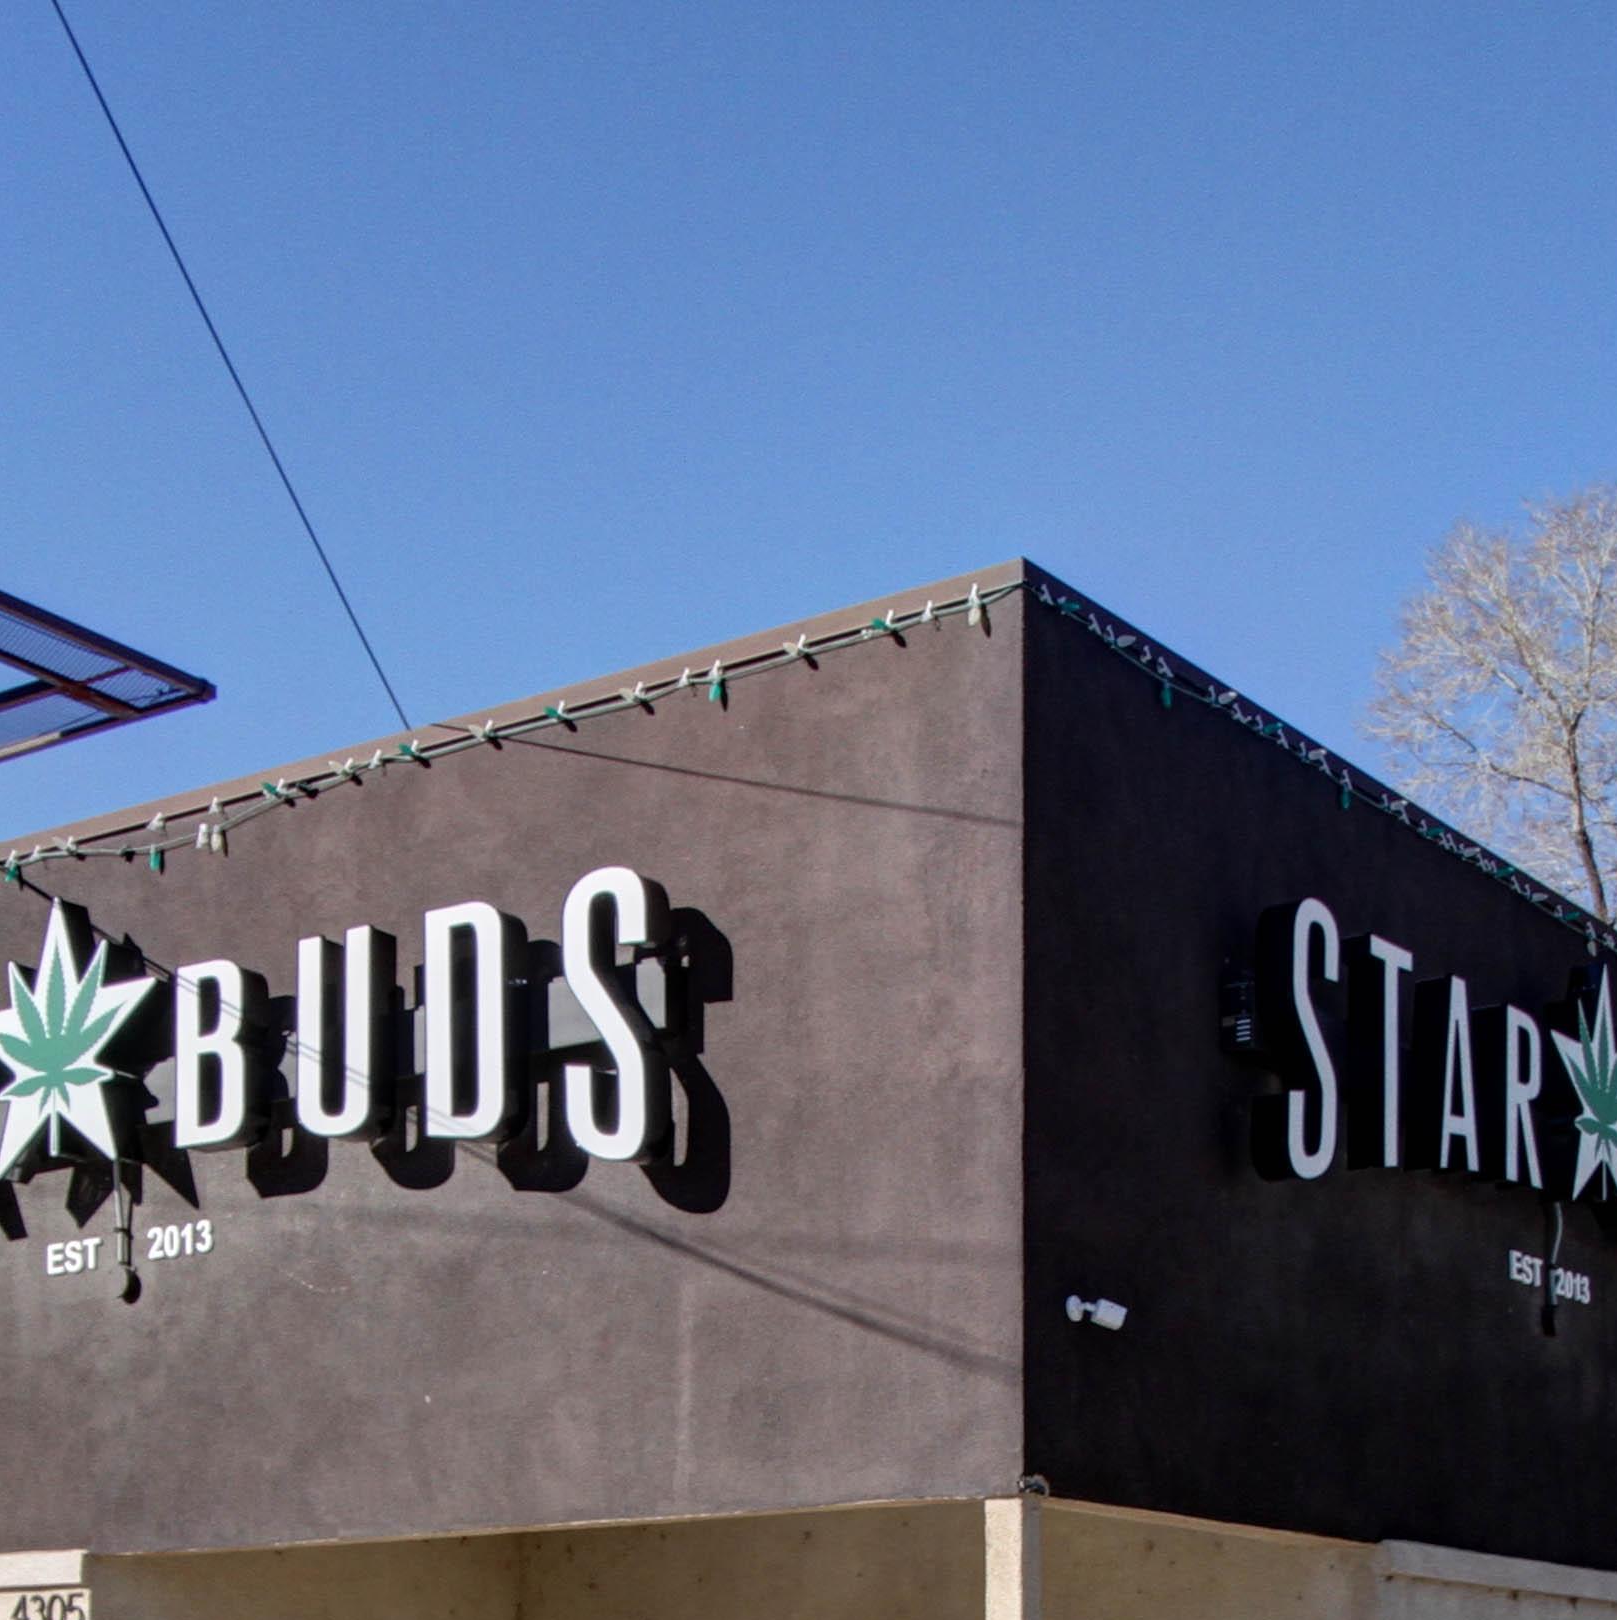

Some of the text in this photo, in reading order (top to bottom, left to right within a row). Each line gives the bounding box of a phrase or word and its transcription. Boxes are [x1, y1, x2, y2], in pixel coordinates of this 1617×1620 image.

[176, 866, 651, 1161] BUDS
[1288, 897, 1543, 1190] STAR
[46, 1220, 214, 1276] EST 2013
[1508, 1249, 1591, 1305] EST 2013
